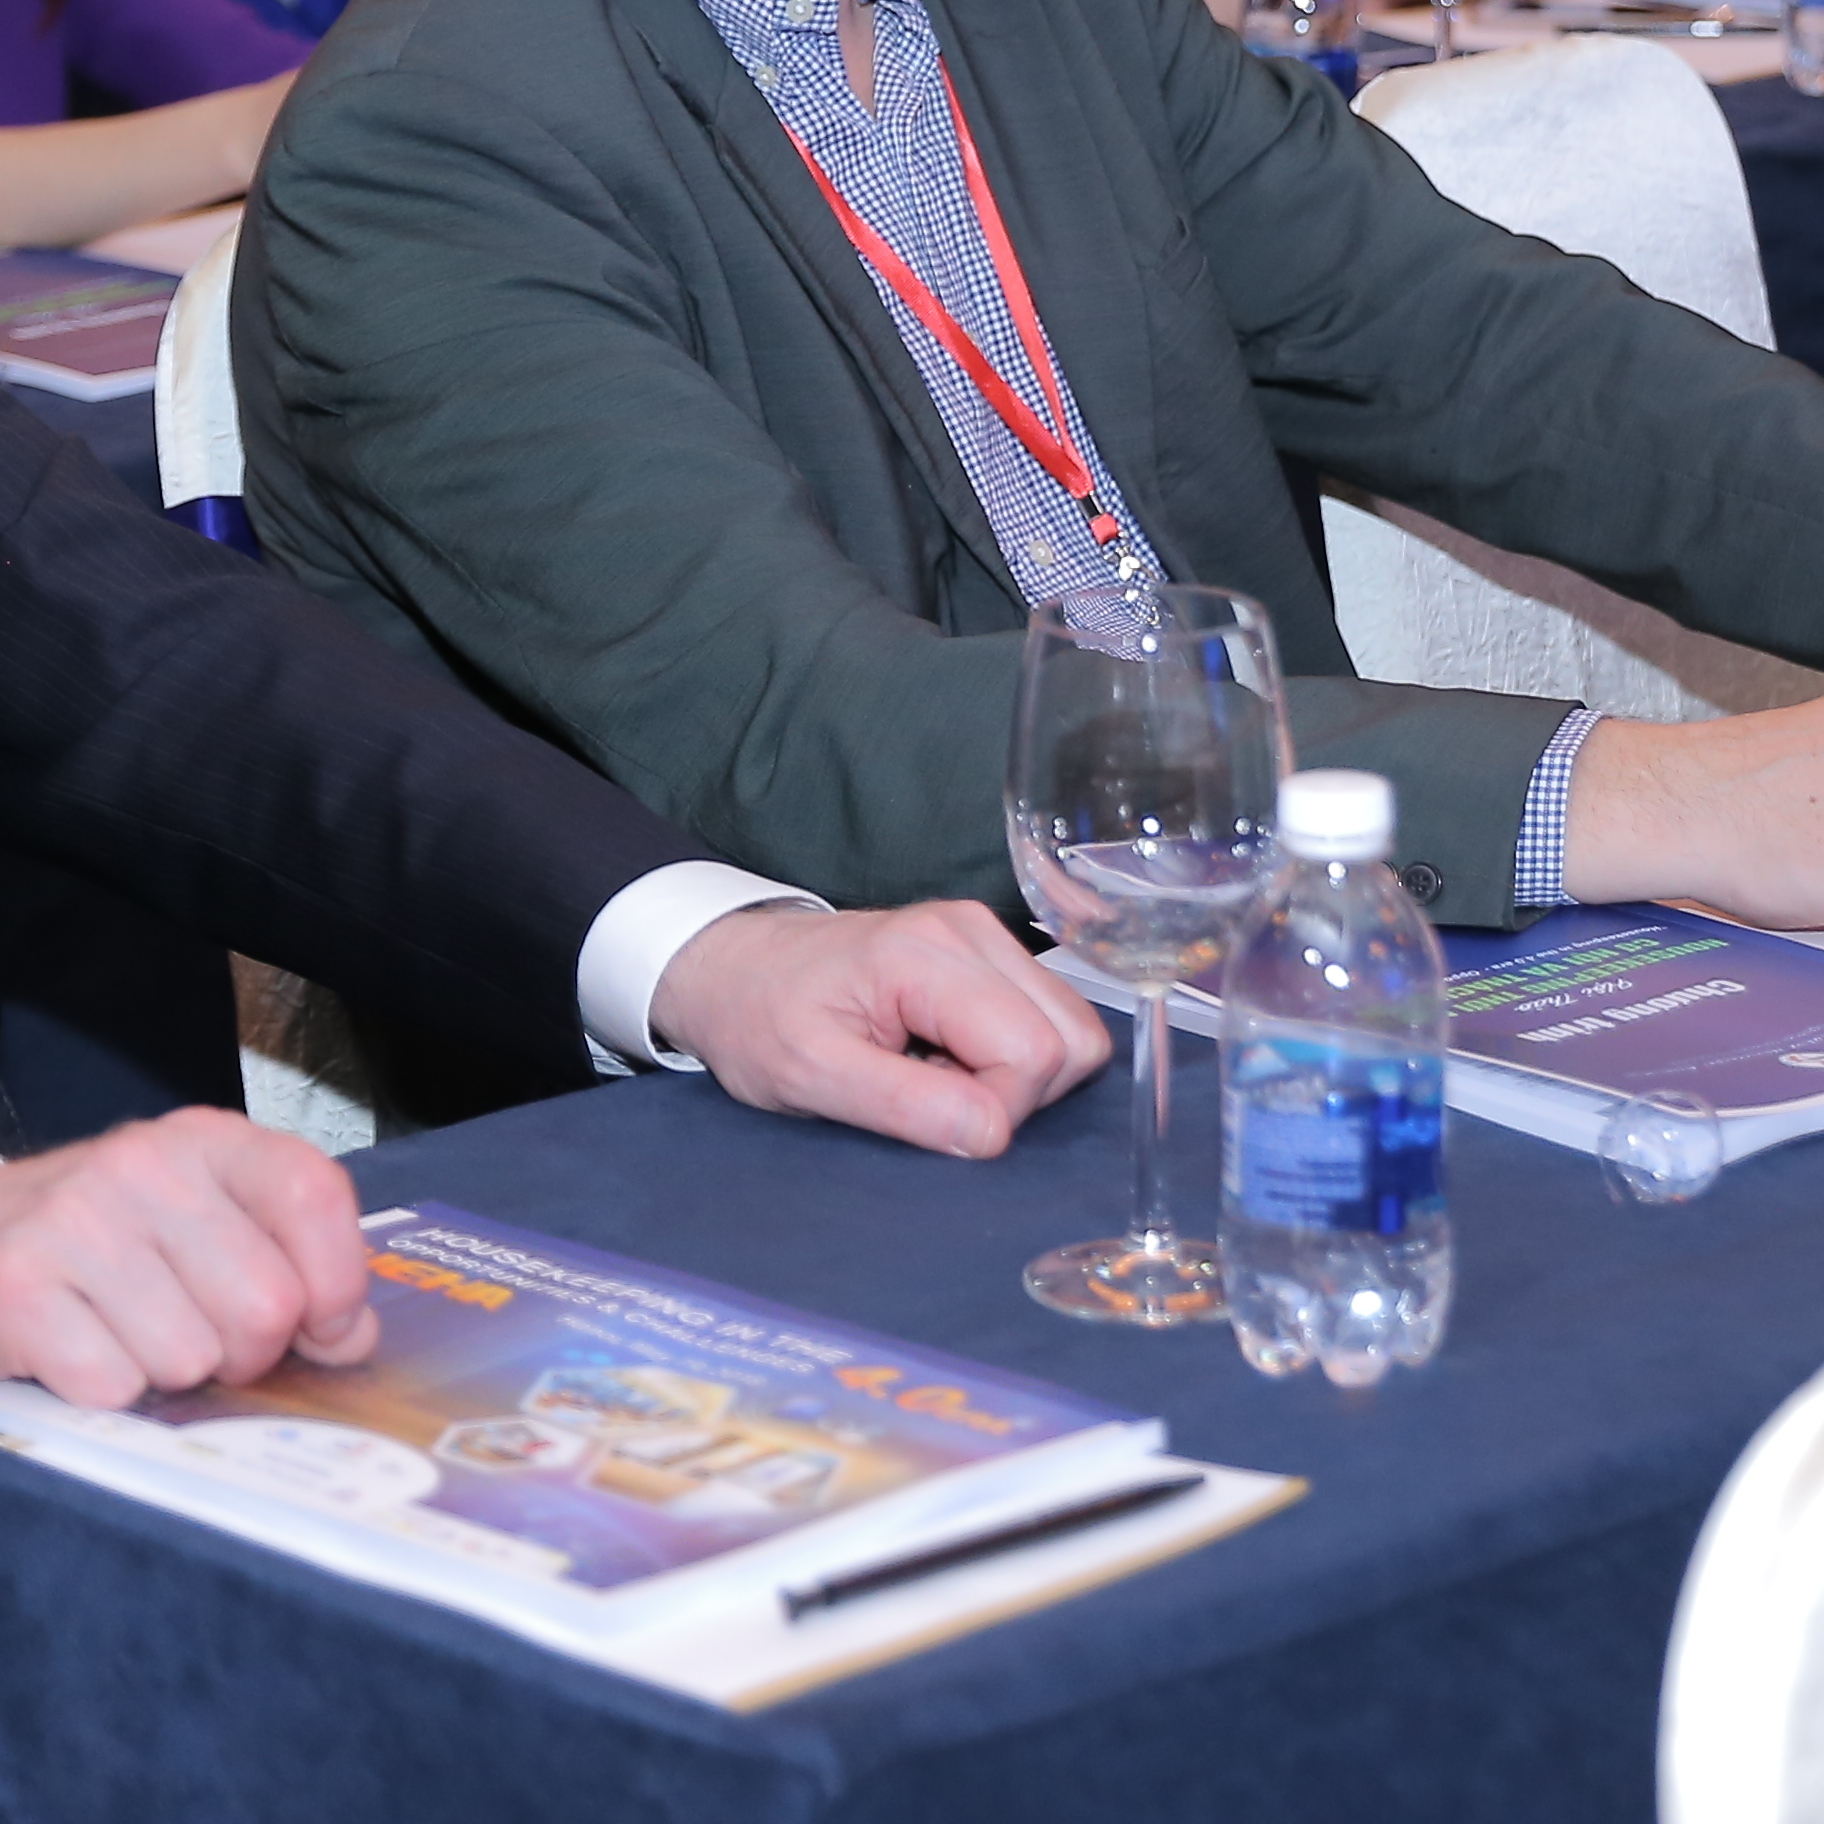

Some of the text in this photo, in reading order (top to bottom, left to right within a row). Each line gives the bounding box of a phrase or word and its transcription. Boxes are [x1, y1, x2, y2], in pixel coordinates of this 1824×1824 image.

[1516, 978, 1747, 1043] Chương trình
[1520, 938, 1729, 994] HOUSEKEEPING
[386, 1237, 597, 1306] OPPORTUNITIES
[597, 1302, 620, 1315] &
[624, 1311, 816, 1373] CHALLENGES
[416, 1226, 716, 1328] HOUSEKEEPING
[716, 1321, 766, 1342] IN
[770, 1332, 853, 1365] THE
